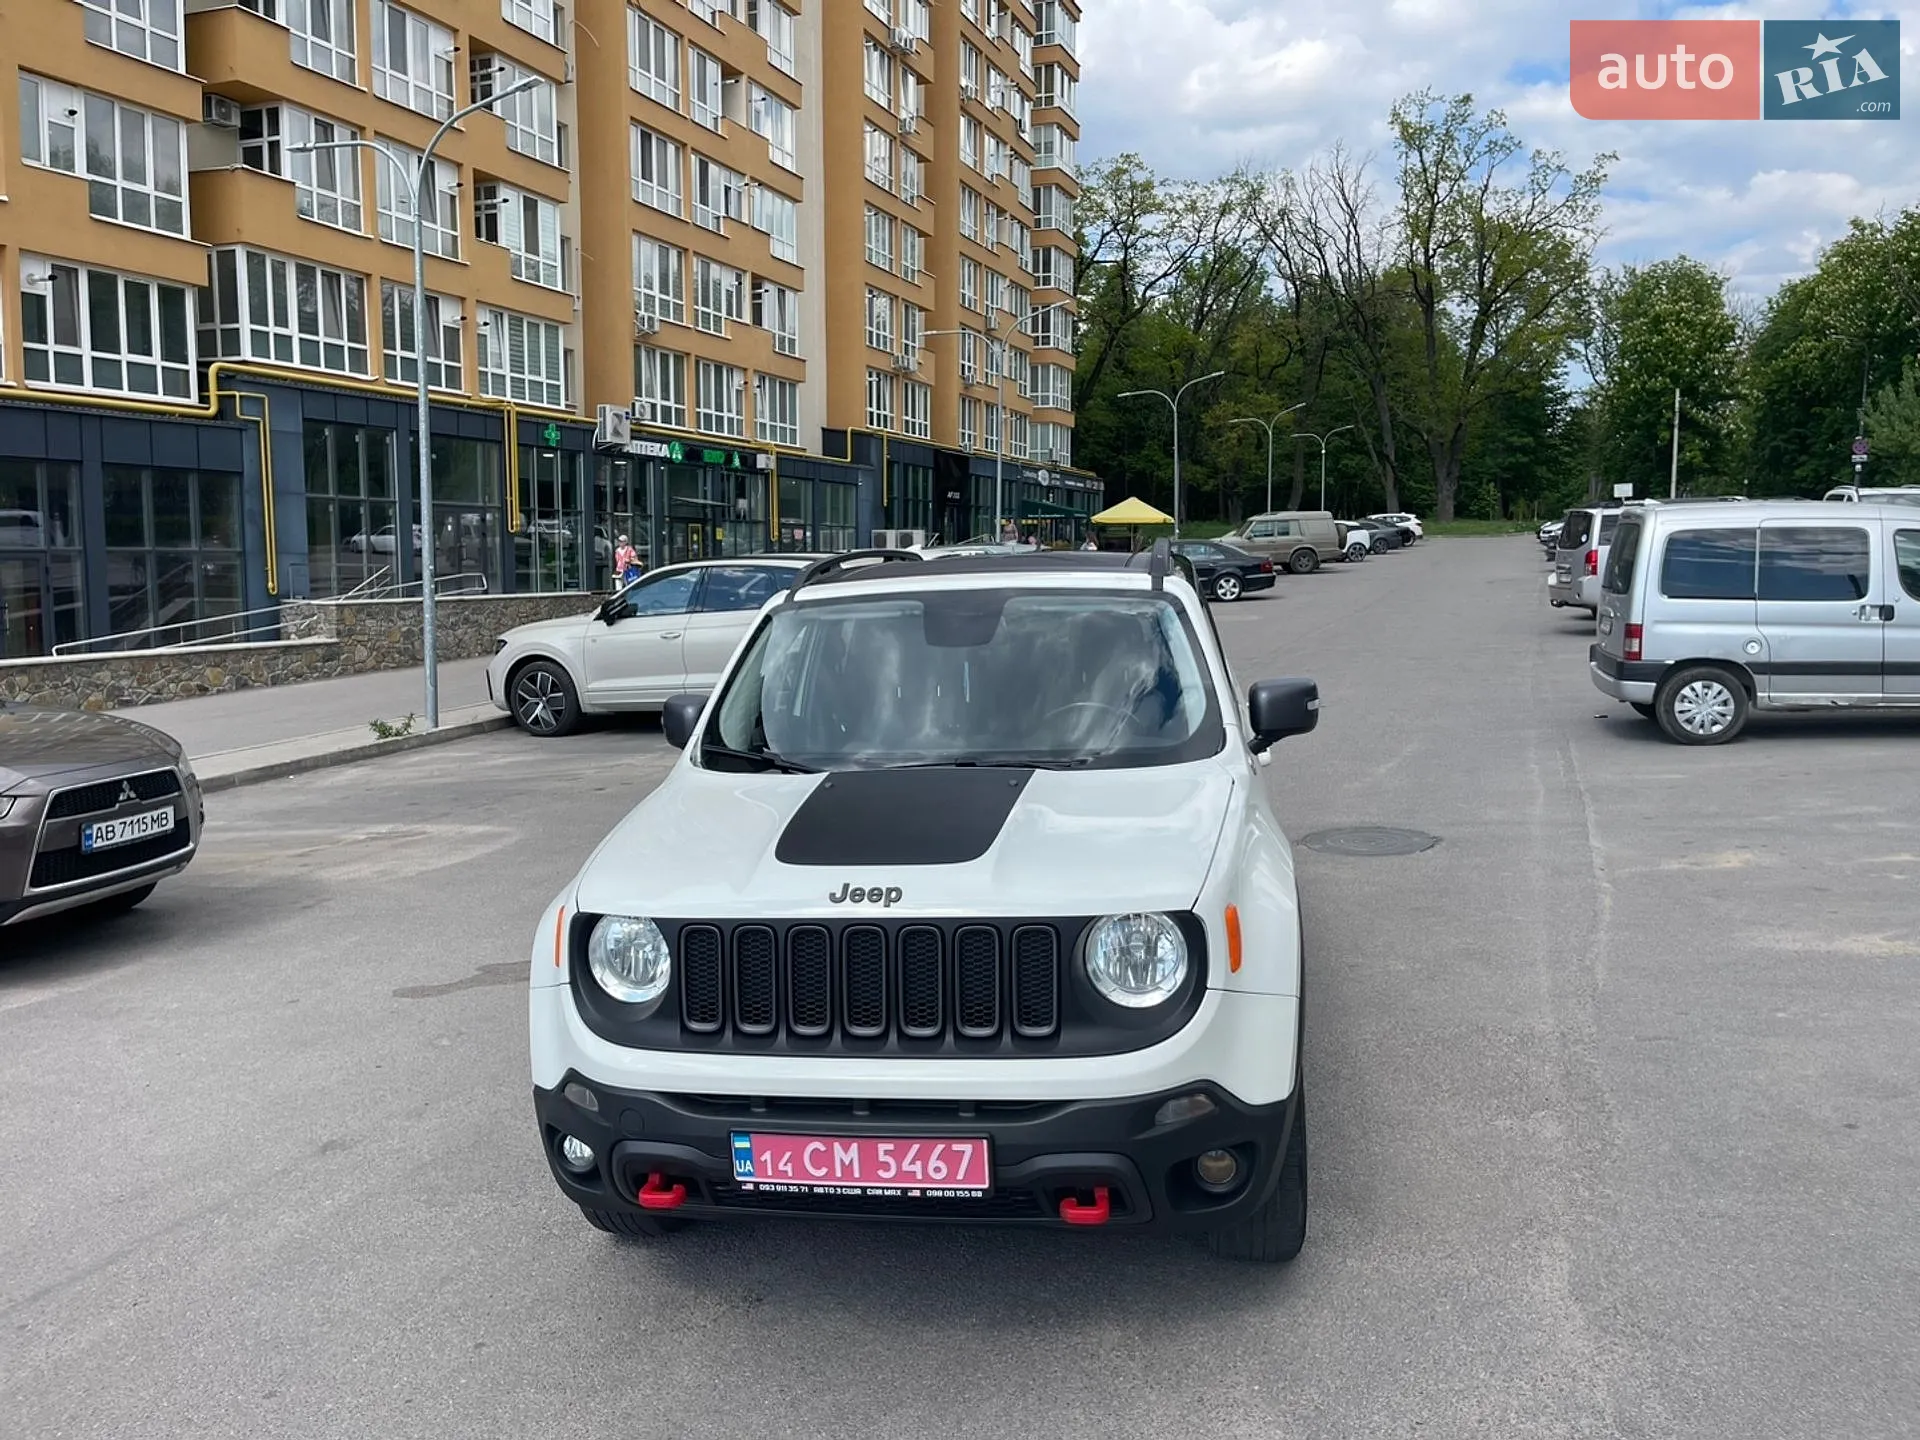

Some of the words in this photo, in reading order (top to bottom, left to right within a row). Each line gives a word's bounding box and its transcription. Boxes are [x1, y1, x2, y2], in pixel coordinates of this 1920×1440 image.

[94, 824, 116, 844] AB
[119, 816, 148, 838] 7115
[150, 811, 169, 831] MB
[829, 882, 903, 908] Jeep
[736, 1160, 754, 1173] UA
[759, 1150, 793, 1177] 14
[803, 1141, 860, 1178] CM
[876, 1143, 973, 1180] 5467
